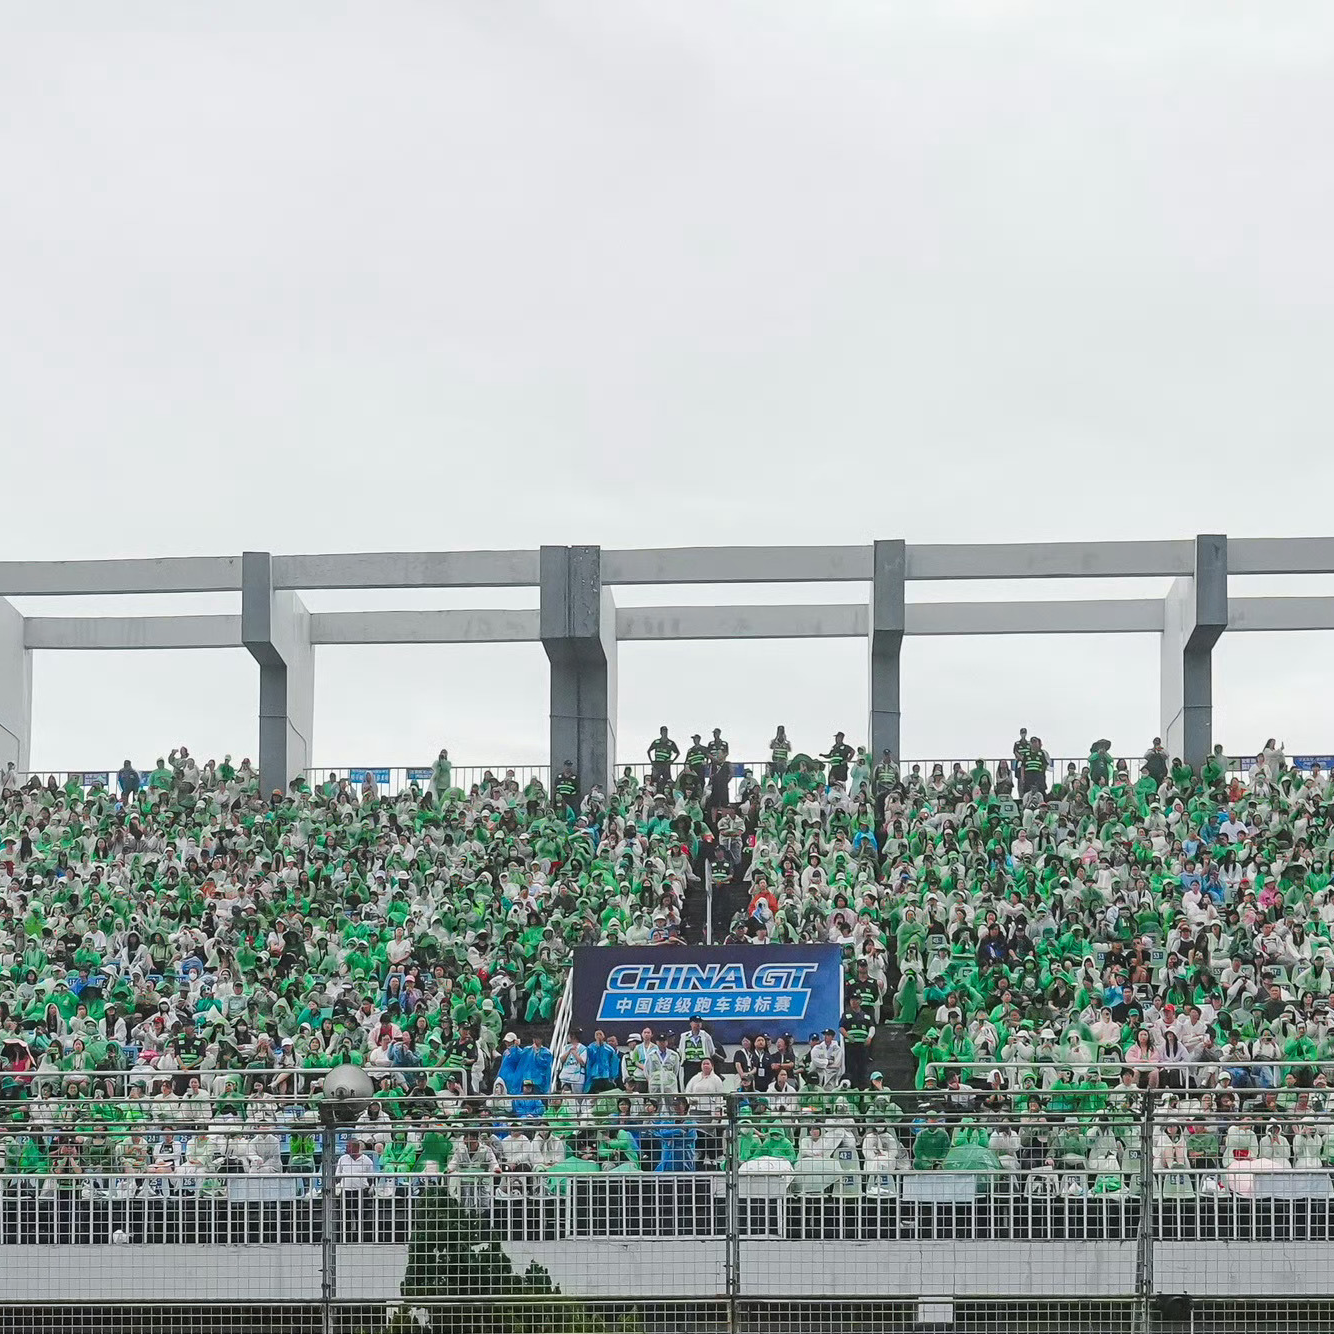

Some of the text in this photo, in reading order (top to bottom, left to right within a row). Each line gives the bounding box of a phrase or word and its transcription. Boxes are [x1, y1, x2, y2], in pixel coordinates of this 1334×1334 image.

[606, 962, 819, 991] CHINA GT
[615, 995, 793, 1013] 中国超级跑车锦标赛
